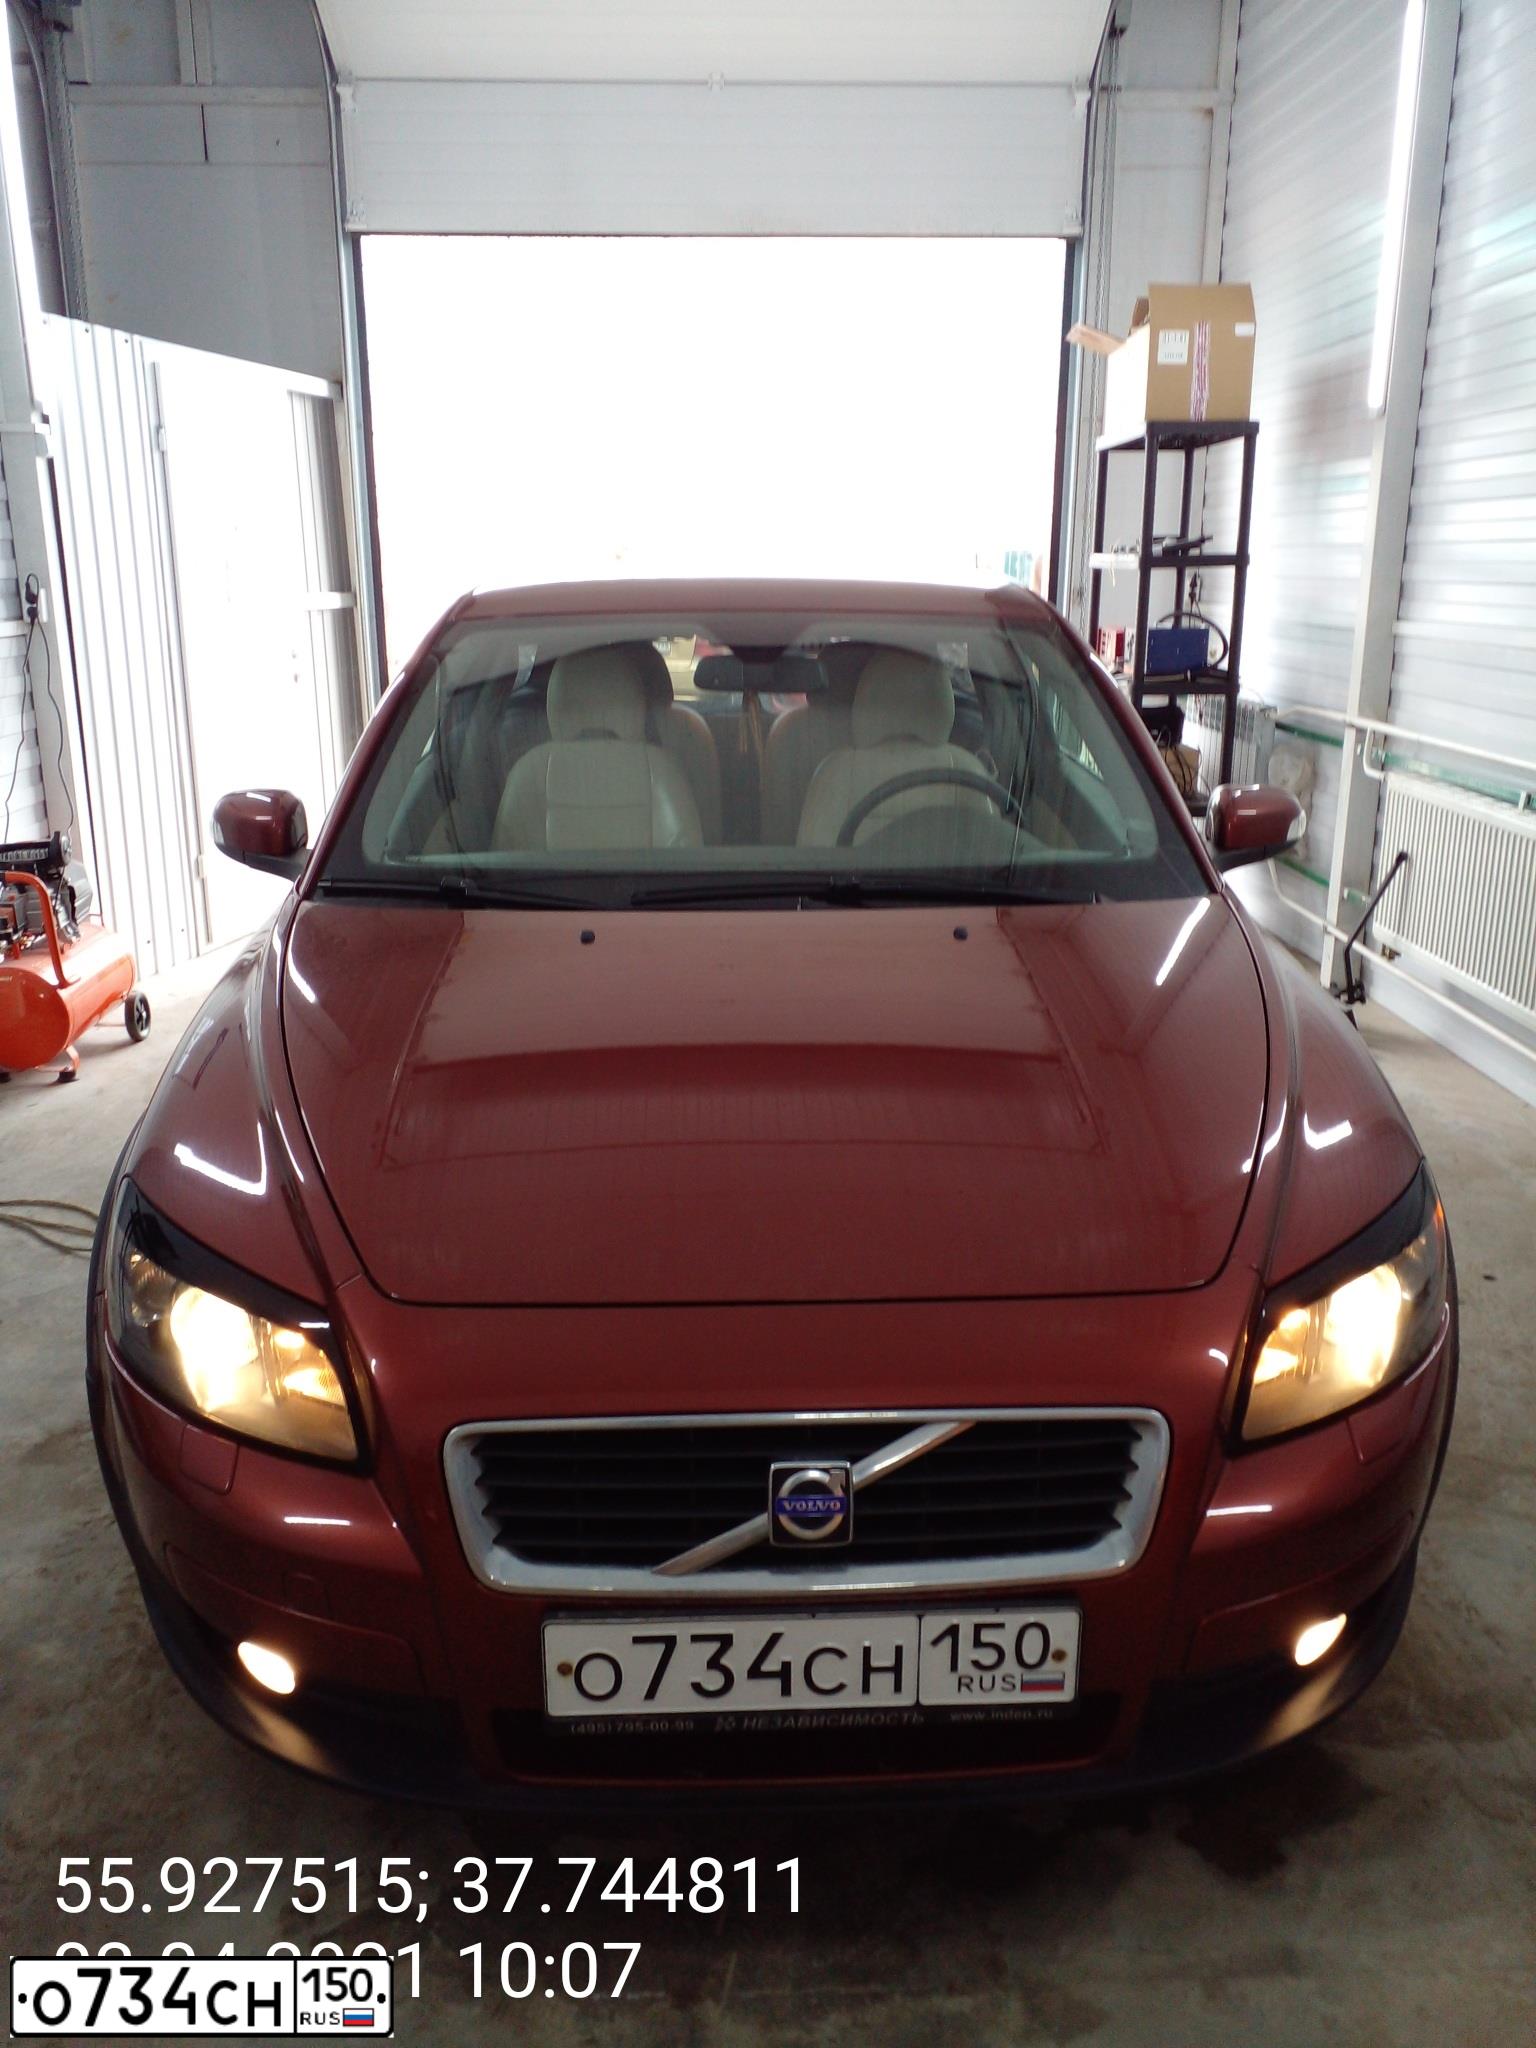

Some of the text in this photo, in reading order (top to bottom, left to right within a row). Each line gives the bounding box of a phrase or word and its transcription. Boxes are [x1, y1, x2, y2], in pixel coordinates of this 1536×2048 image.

[783, 1499, 841, 1513] VOLVO
[929, 1621, 1051, 1674] 150
[957, 1673, 1017, 1694] RUS
